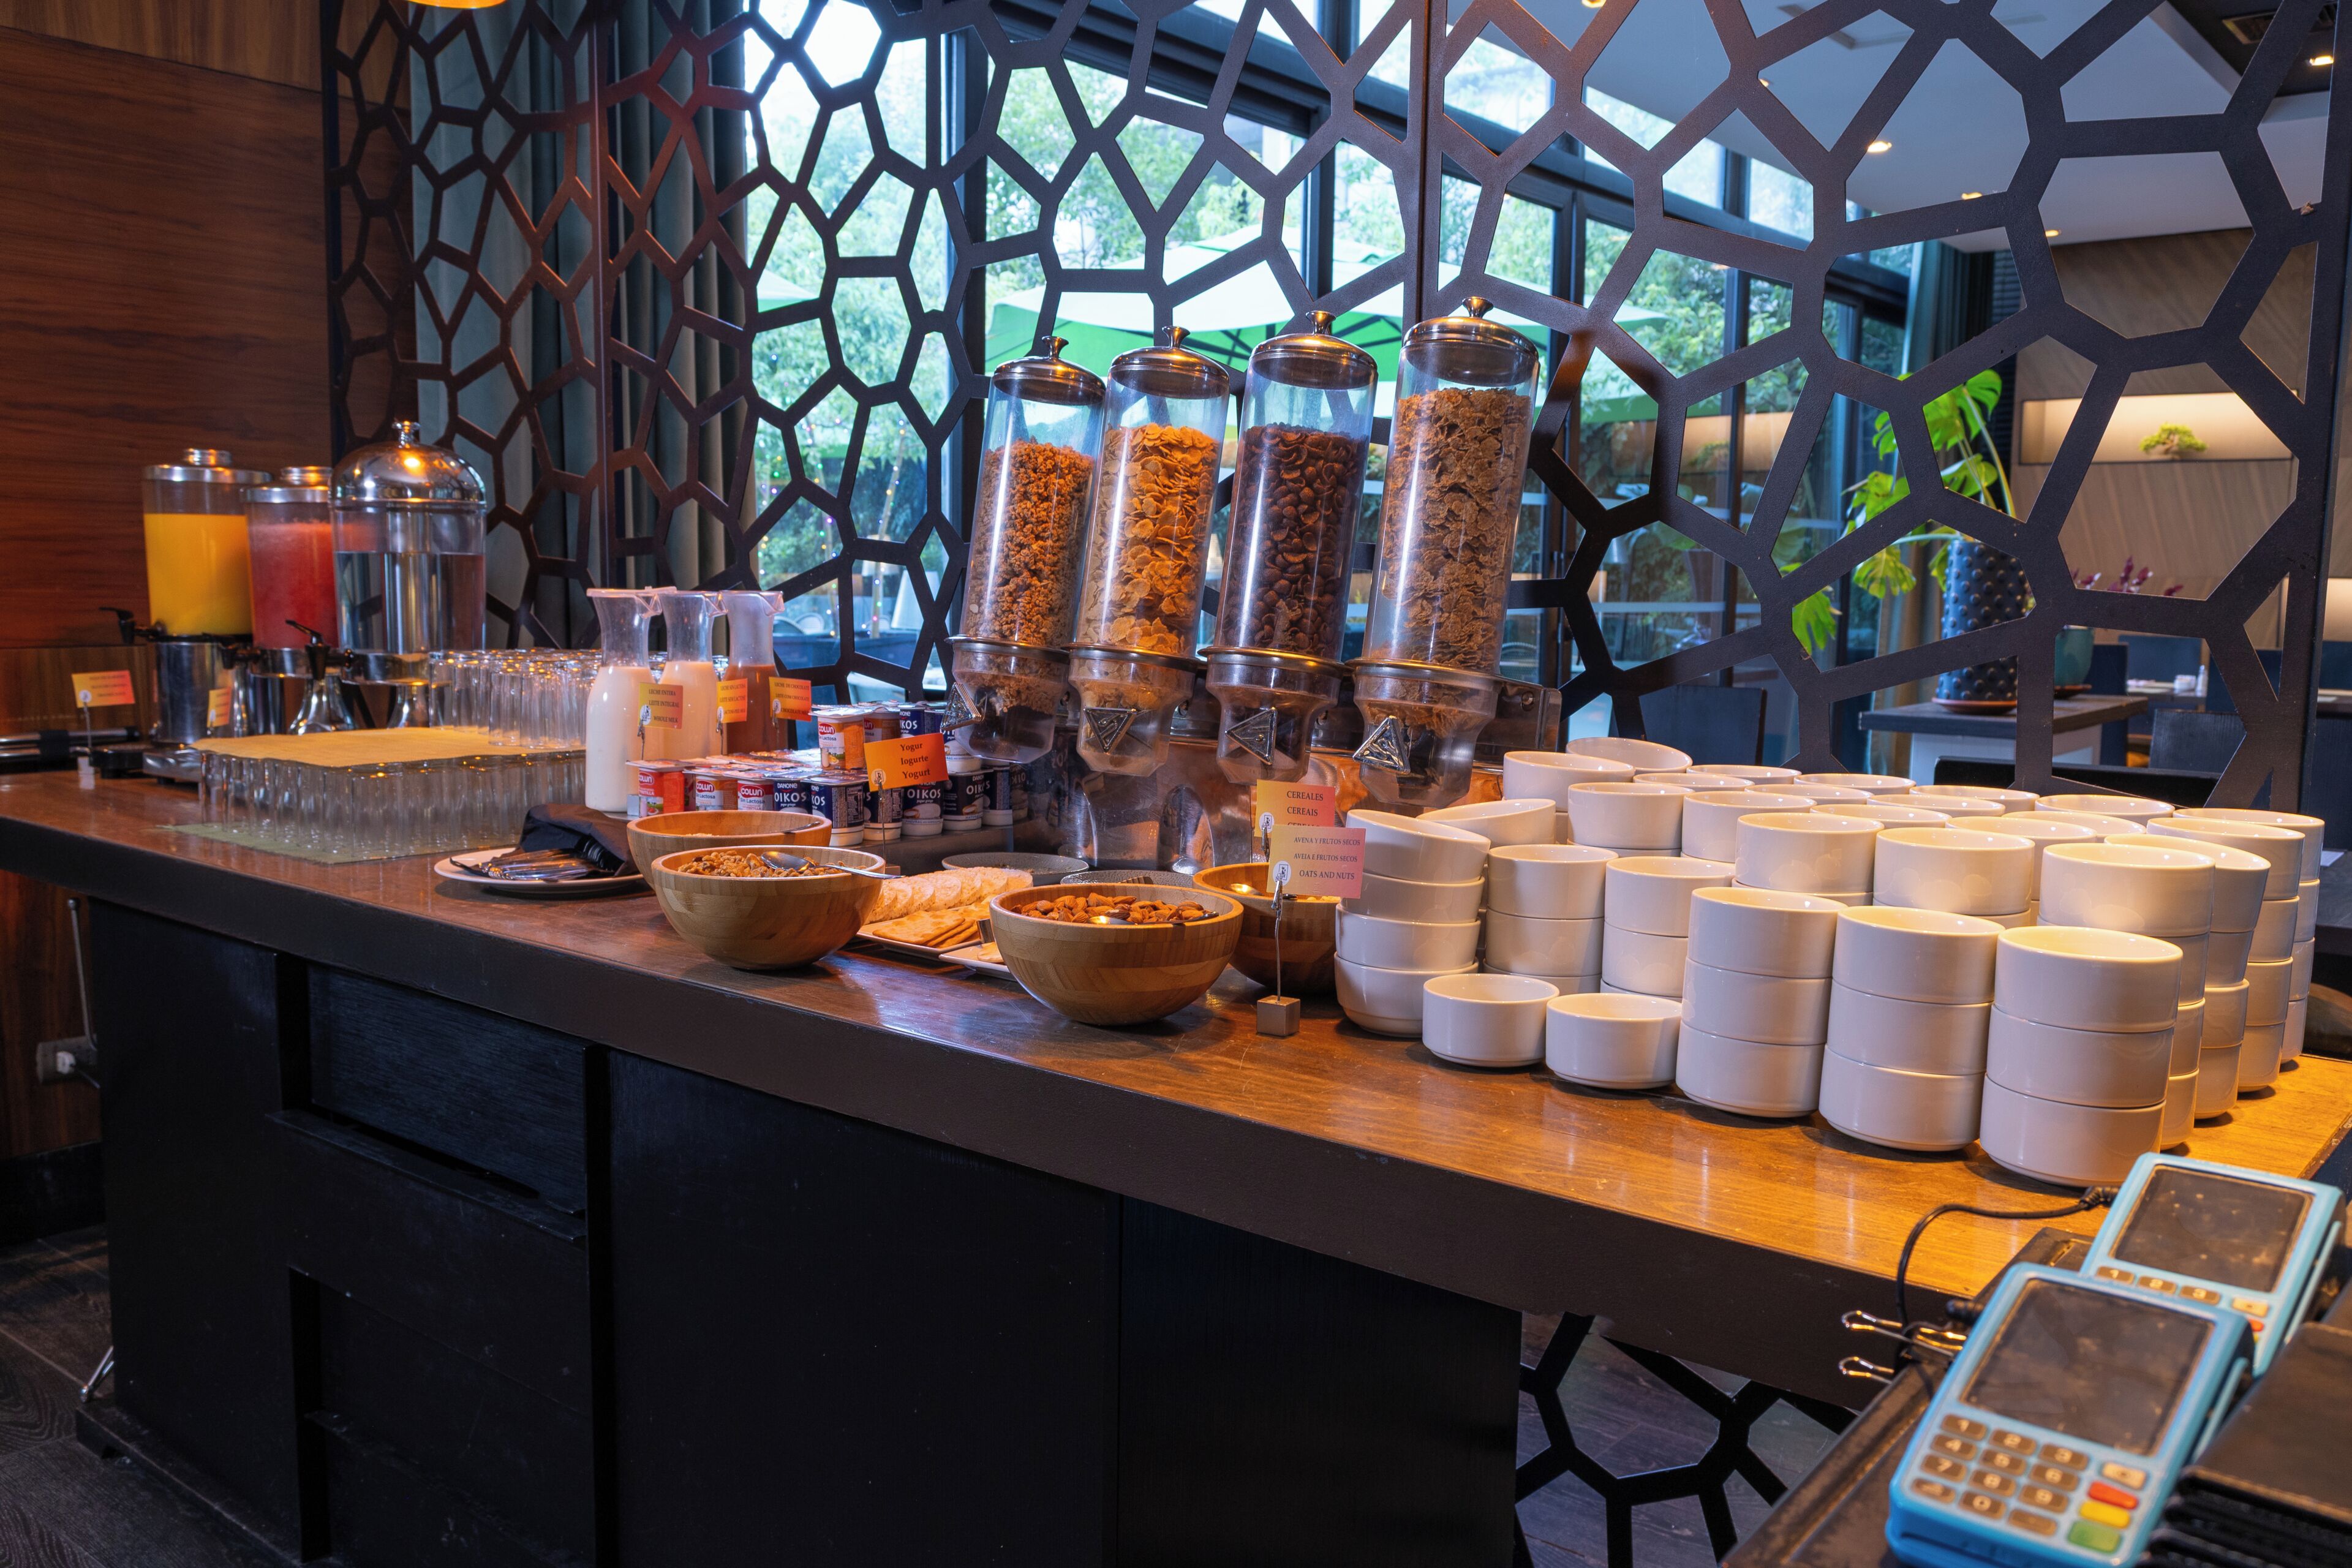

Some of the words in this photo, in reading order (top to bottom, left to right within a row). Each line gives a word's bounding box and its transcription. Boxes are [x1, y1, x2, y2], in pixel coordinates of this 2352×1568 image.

[900, 720, 918, 729] IKOS
[900, 743, 923, 752] Yogur
[900, 755, 929, 766] Iogurte
[639, 775, 652, 783] OLUN
[902, 769, 930, 780] Yogurt
[696, 783, 714, 791] COLUN
[741, 788, 763, 796] COLUN
[774, 792, 807, 802] OIKOS
[907, 788, 941, 799] OIKOS
[1286, 790, 1324, 801] CEREALES
[1287, 806, 1318, 816] CEREAIS
[1945, 1438, 1962, 1452] 4
[1958, 1419, 1970, 1432] 1
[2003, 1433, 2022, 1448] 2
[2054, 1448, 2073, 1463] 3
[1936, 1458, 1954, 1472] 7
[1972, 1494, 1992, 1512] 0
